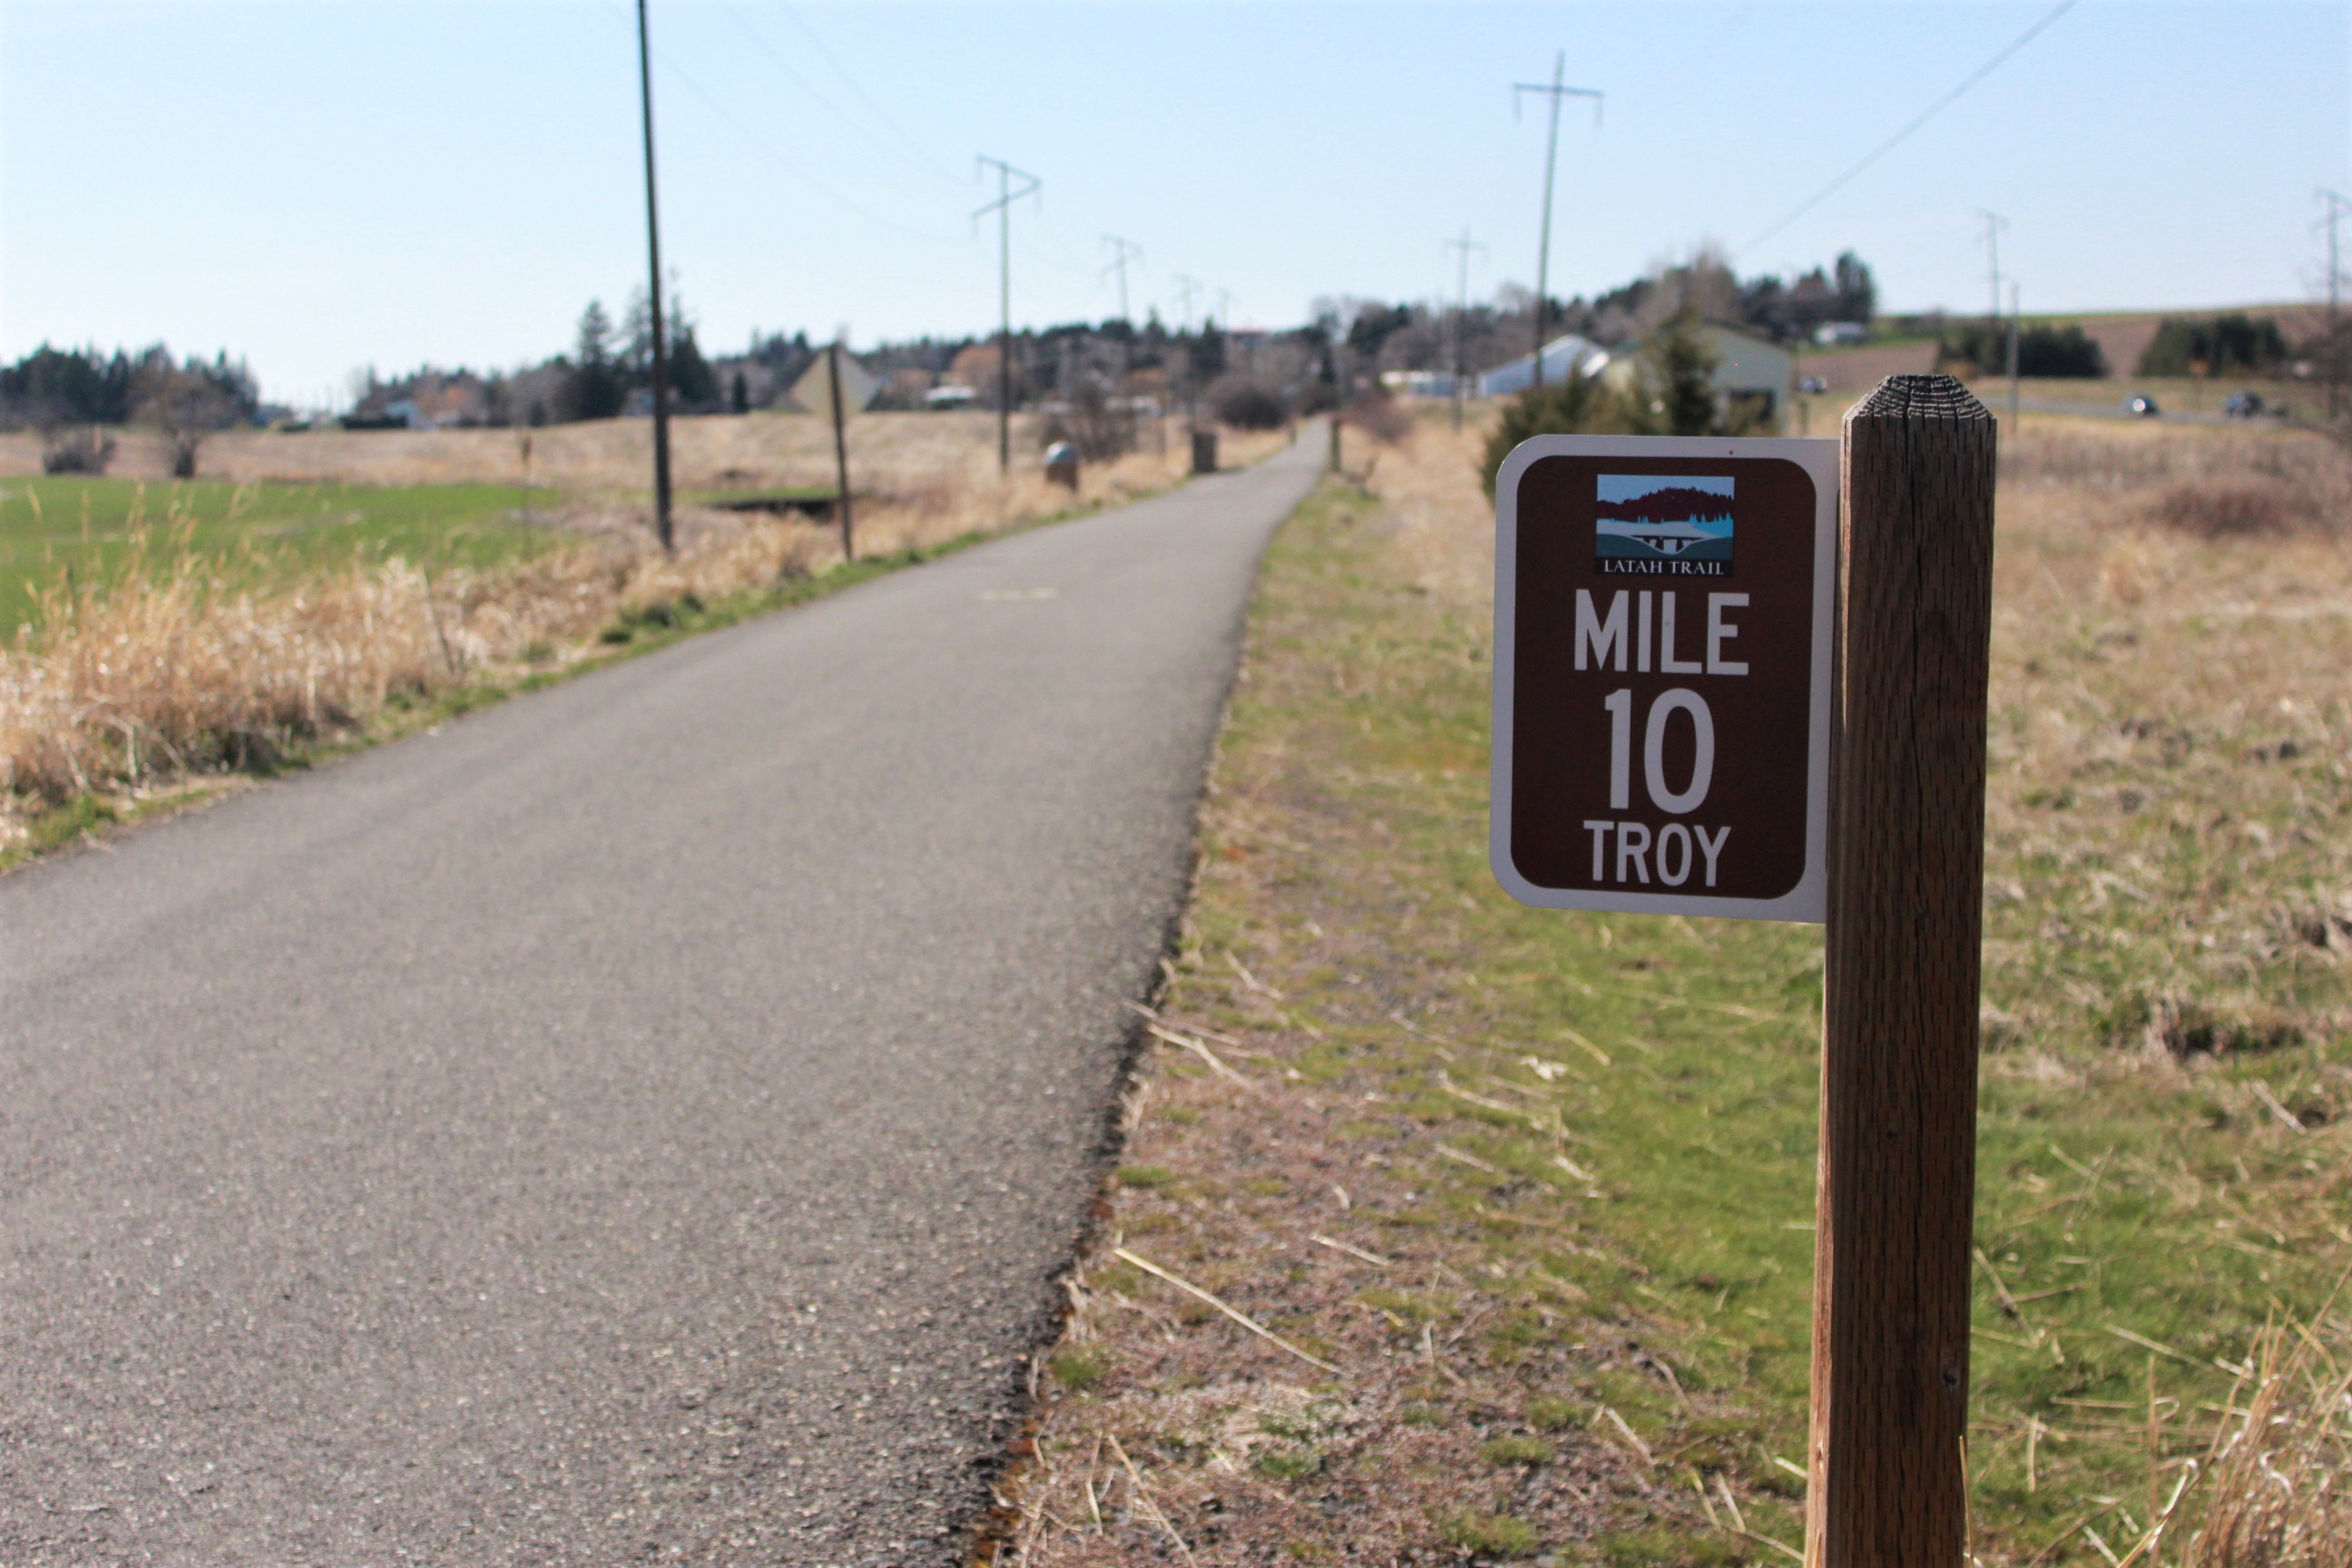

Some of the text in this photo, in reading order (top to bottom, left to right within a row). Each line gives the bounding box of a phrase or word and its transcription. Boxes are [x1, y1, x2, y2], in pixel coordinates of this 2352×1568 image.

[1604, 560, 1724, 575] LATAH TRAIL
[1574, 589, 1749, 675] MILE
[1604, 688, 1715, 814] 10
[1583, 820, 1731, 887] TROY
